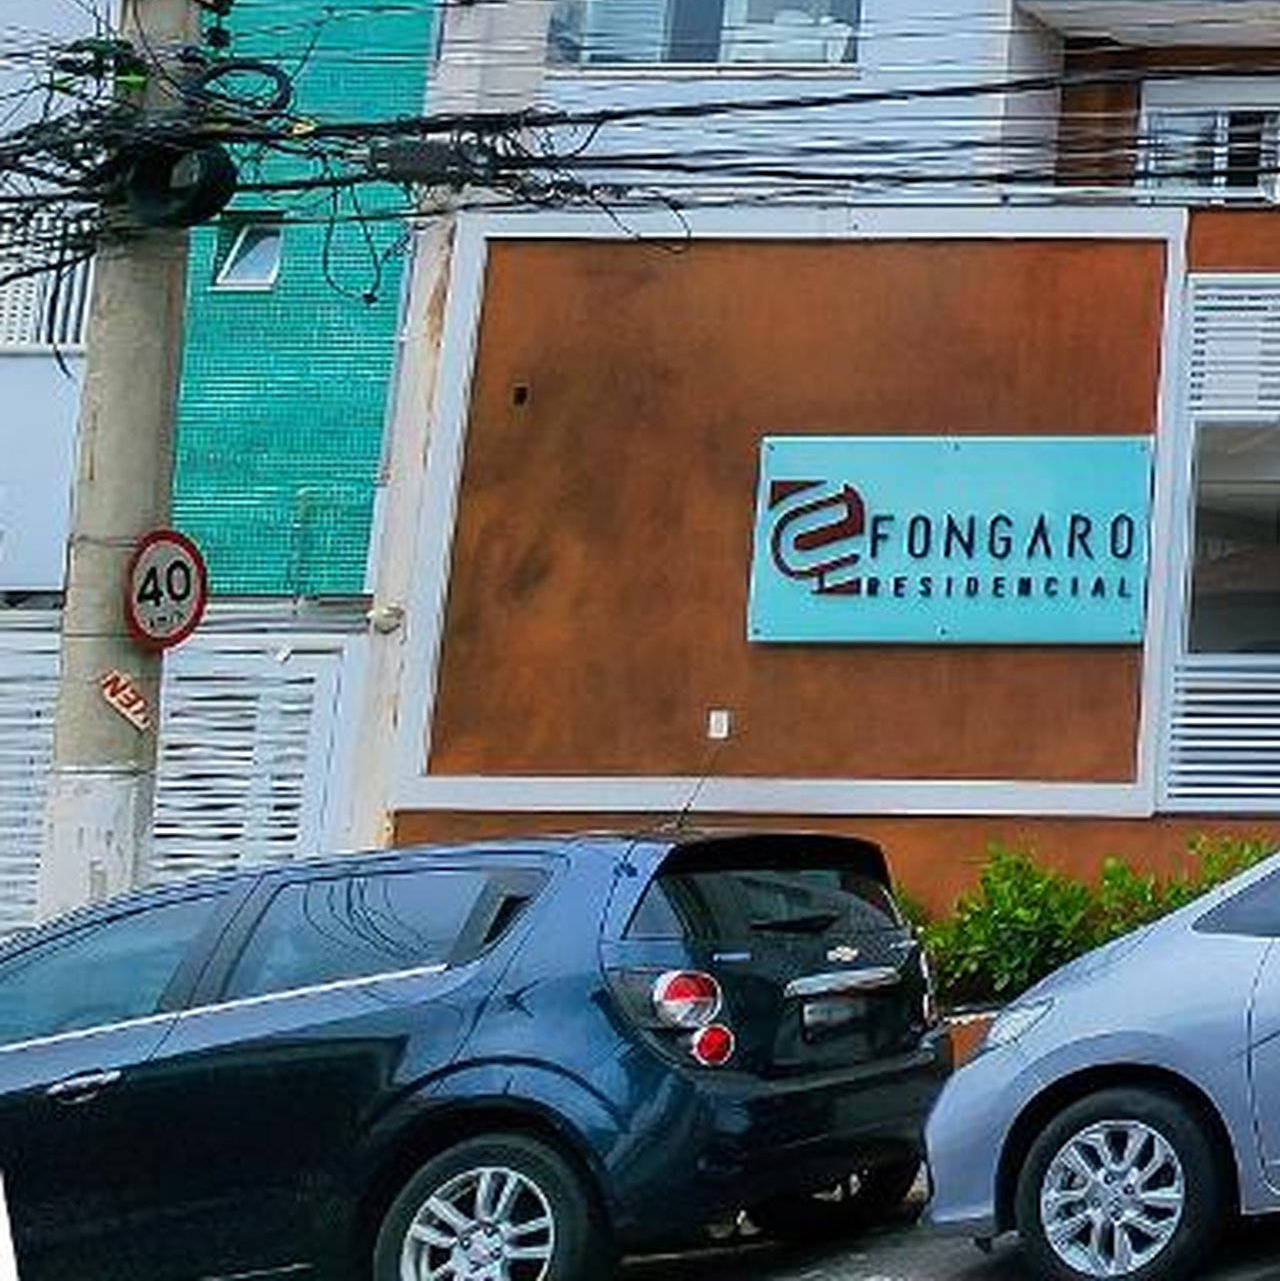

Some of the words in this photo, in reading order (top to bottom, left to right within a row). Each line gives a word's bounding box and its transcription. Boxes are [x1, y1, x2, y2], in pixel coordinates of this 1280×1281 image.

[869, 513, 1136, 561] FONGARO
[137, 560, 192, 607] 40
[865, 575, 1134, 599] RESIDENCIAL
